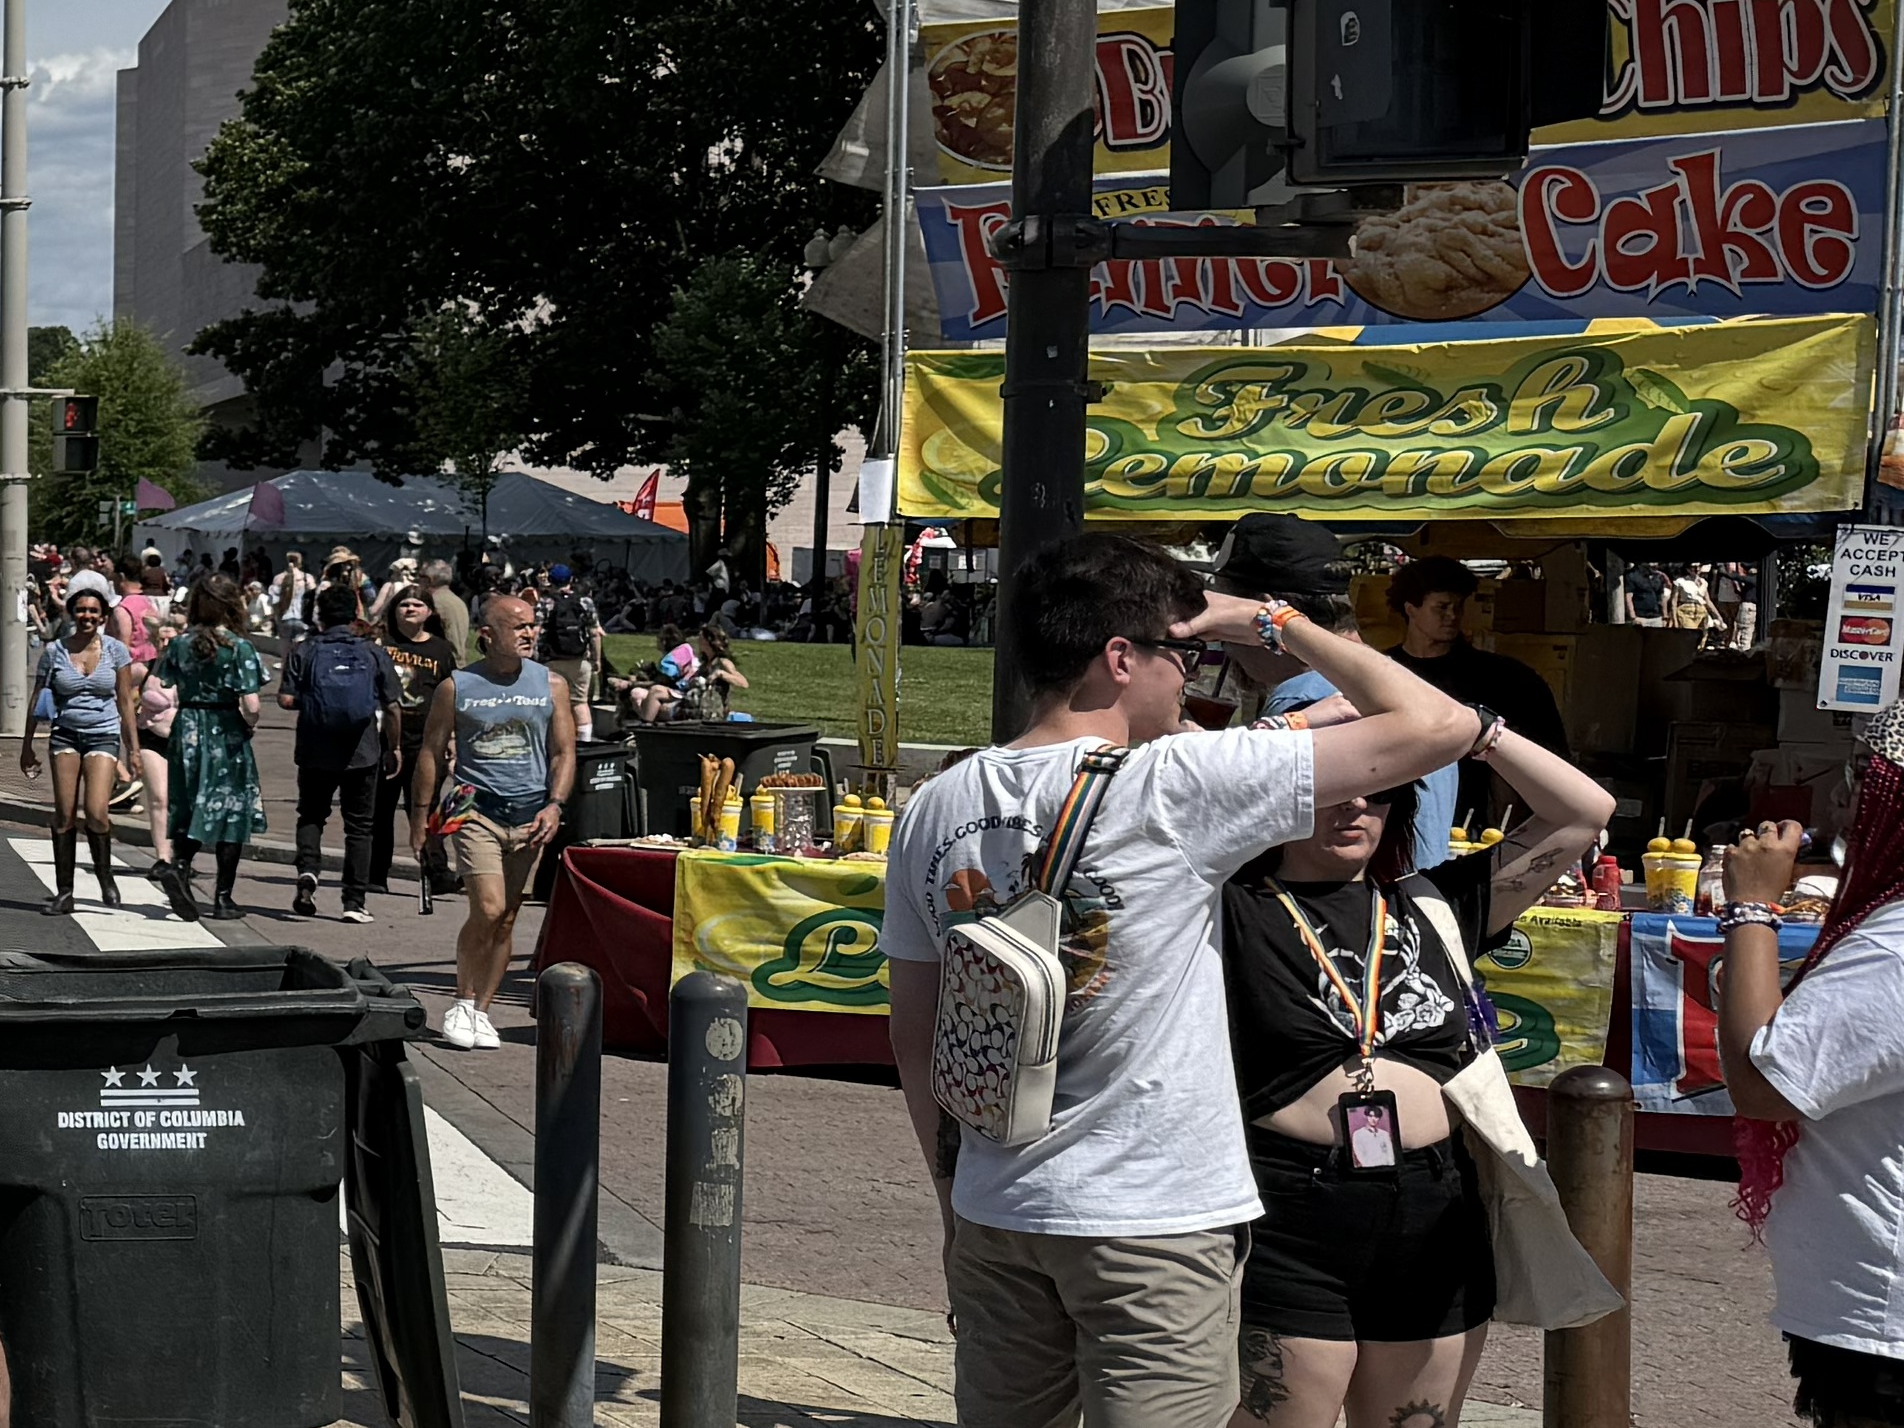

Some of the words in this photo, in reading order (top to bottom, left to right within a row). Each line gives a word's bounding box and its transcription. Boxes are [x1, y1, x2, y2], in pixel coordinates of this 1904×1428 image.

[1095, 188, 1171, 218] FRE
[1518, 147, 1861, 304] Cake
[1179, 350, 1617, 443] Fresh
[1085, 413, 1792, 505] emonade
[1864, 533, 1890, 546] WE
[1849, 564, 1897, 579] CASH
[1857, 594, 1881, 602] VISA
[865, 524, 889, 767] LEMONADE
[1830, 648, 1894, 663] DISCOVER
[459, 698, 497, 712] Frog
[513, 695, 548, 707] Toad
[57, 1111, 131, 1129] DISTRICT
[134, 1111, 156, 1128] OF
[159, 1110, 246, 1128] COLUMBIA
[97, 1132, 208, 1150] GOVERNMENT
